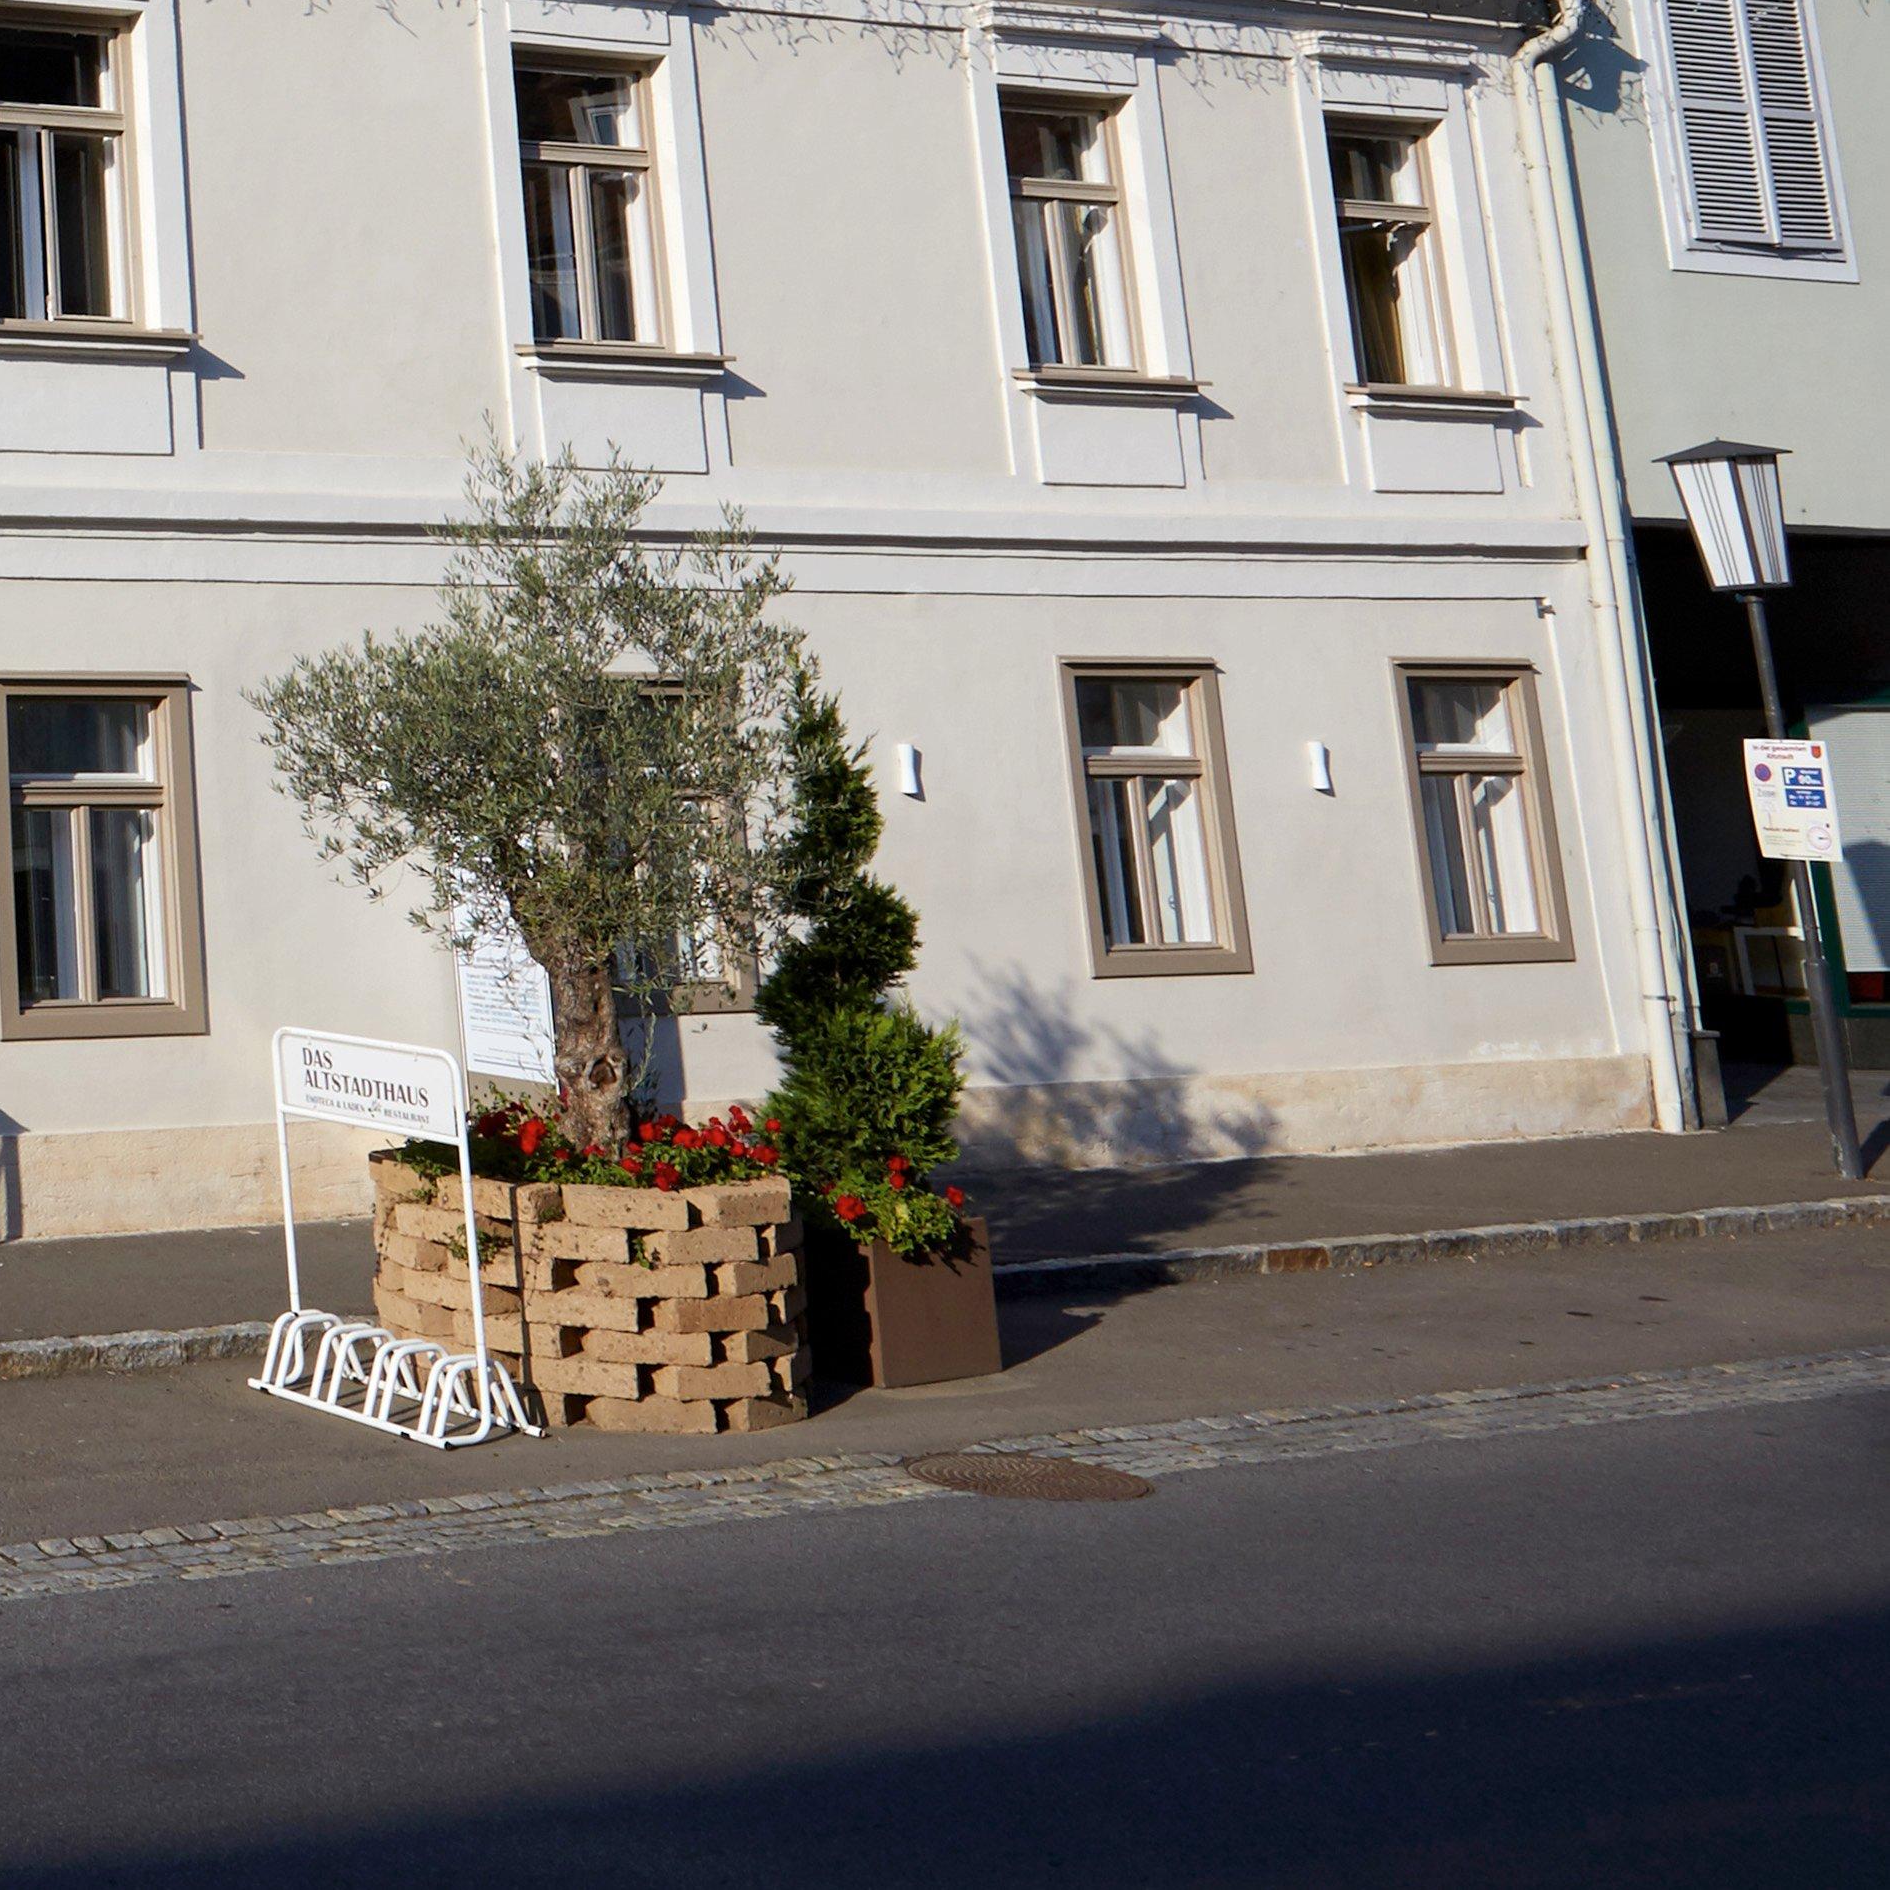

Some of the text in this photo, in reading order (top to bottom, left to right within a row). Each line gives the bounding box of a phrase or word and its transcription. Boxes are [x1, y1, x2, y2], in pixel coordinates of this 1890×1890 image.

[1783, 768, 1797, 784] P
[302, 1047, 333, 1070] DAS
[305, 1069, 429, 1108] ALTSTADTHAUS
[384, 1108, 430, 1124] RESTAURANT
